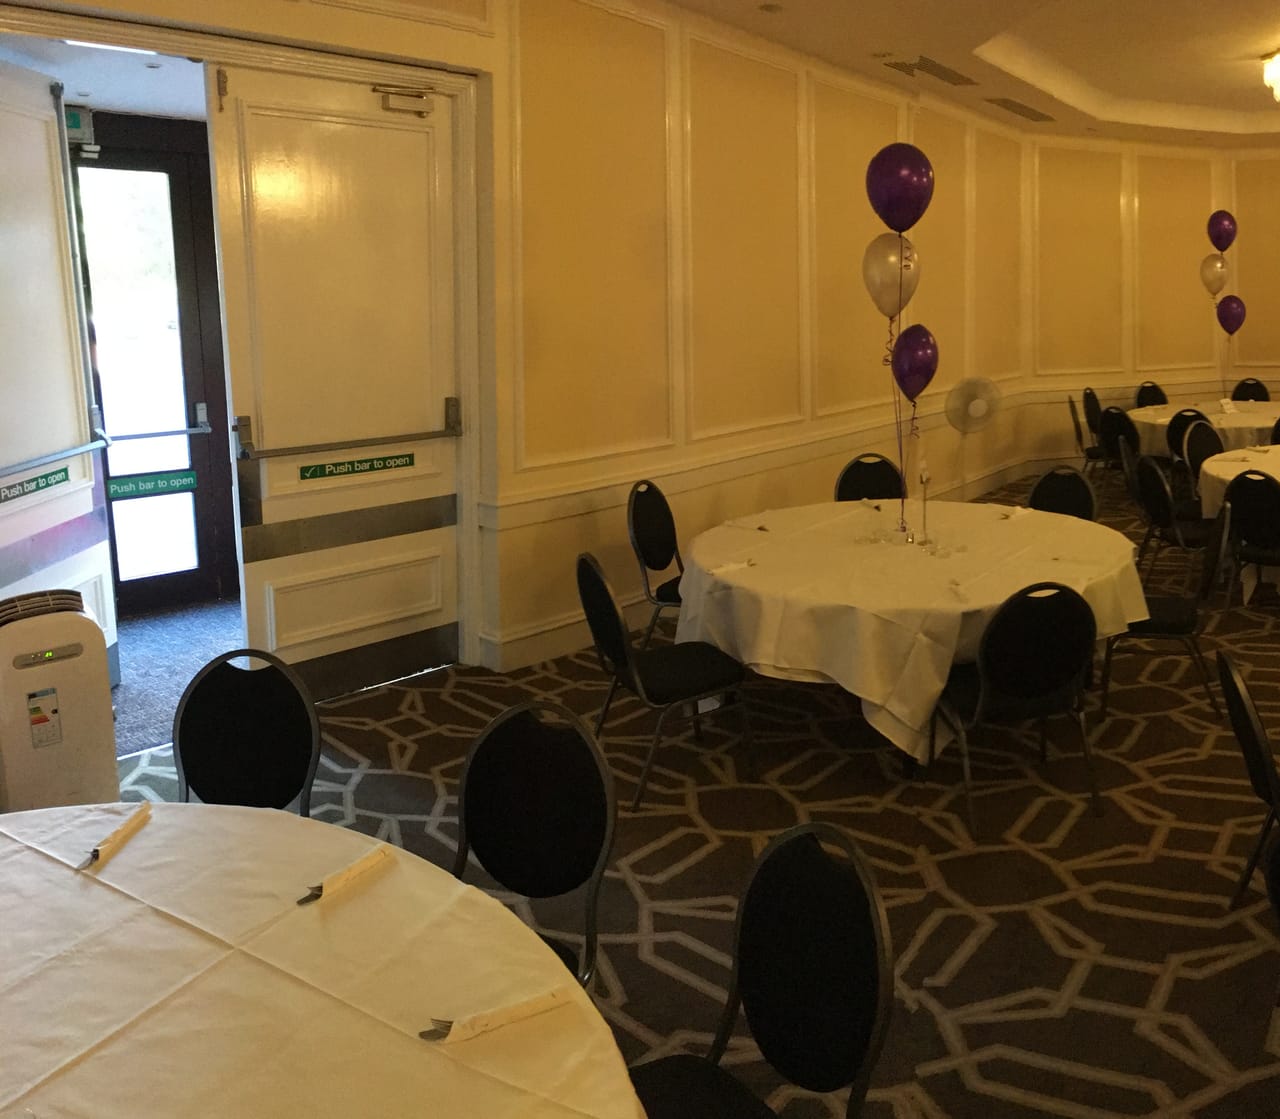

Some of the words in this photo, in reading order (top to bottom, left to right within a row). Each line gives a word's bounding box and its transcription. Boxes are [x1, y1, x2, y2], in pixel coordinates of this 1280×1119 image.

[325, 463, 352, 475] Push
[354, 461, 372, 471] bar
[373, 459, 384, 469] to
[385, 457, 410, 468] open
[0, 484, 23, 500] Push
[23, 481, 37, 492] bar
[38, 477, 47, 488] to
[47, 471, 66, 485] open
[110, 482, 136, 494] Push
[138, 481, 155, 490] bar
[157, 479, 168, 488] to
[170, 477, 194, 488] open
